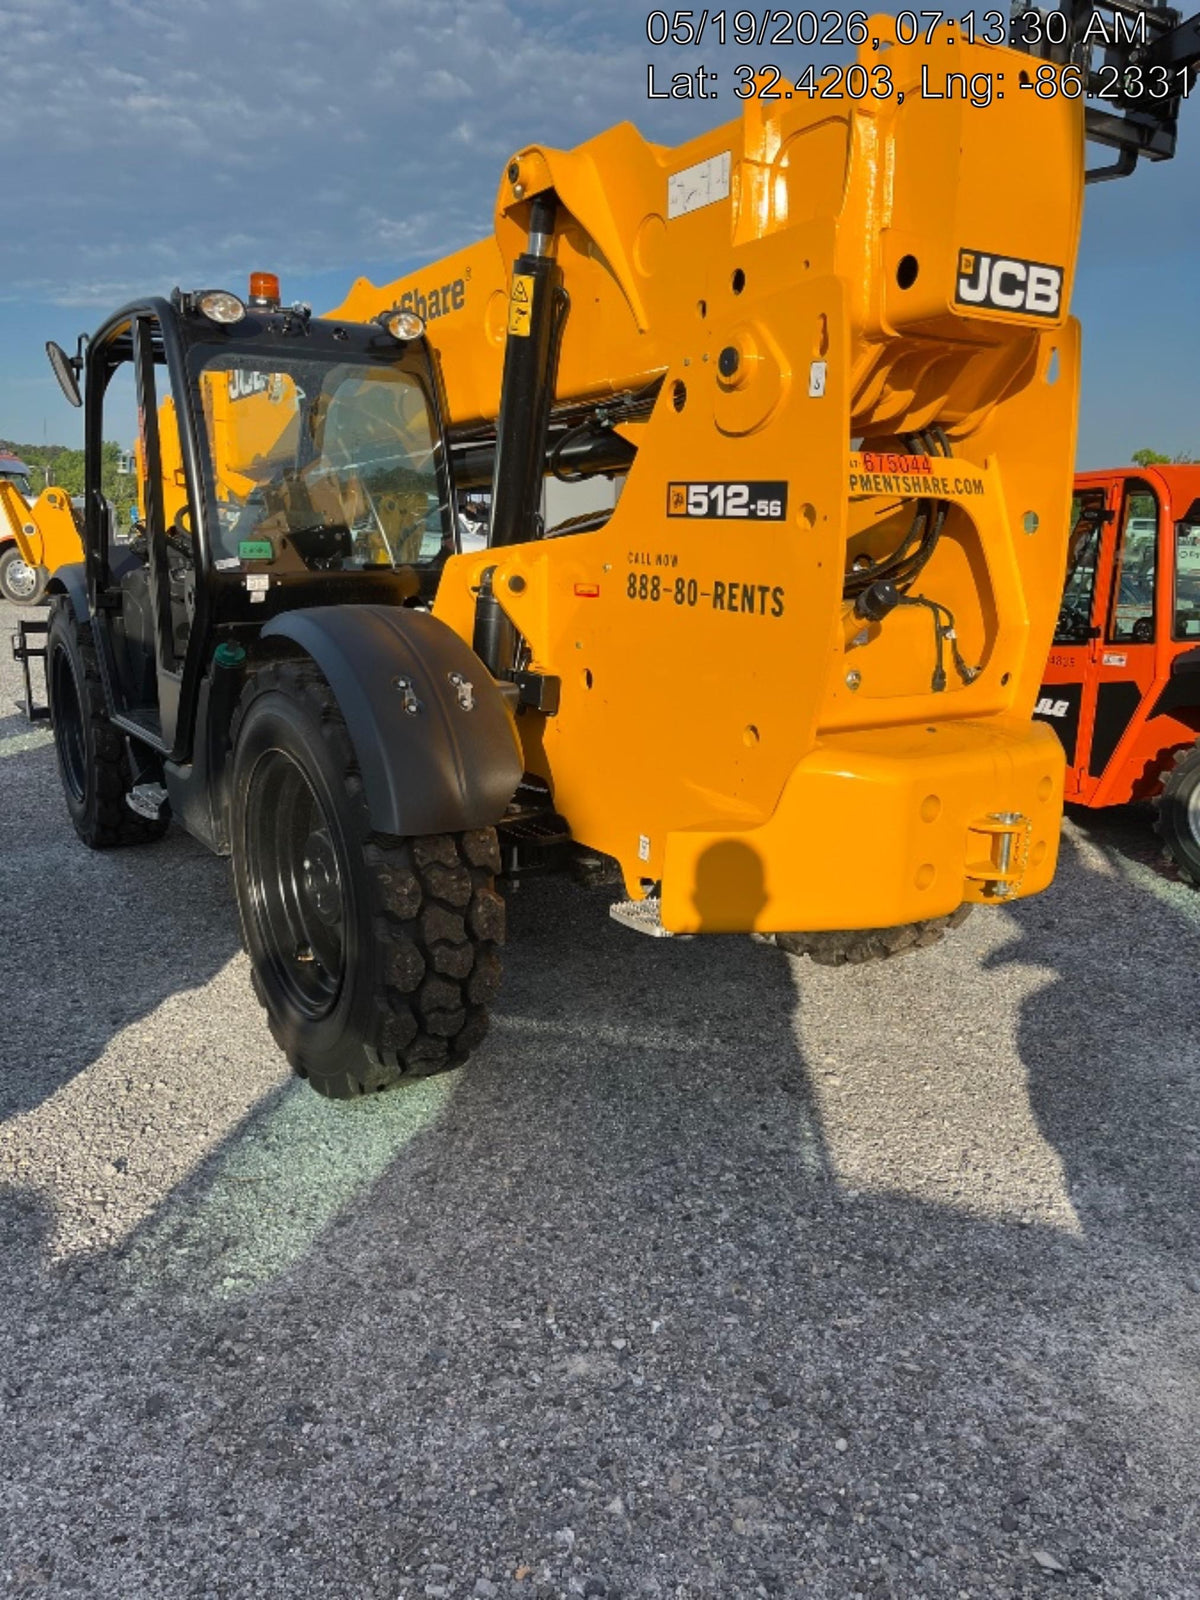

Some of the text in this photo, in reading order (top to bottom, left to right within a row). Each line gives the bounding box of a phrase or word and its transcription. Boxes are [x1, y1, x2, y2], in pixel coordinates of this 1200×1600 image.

[959, 257, 1060, 313] JCB
[687, 484, 782, 517] 512-56
[627, 551, 678, 568] CALL NOW
[626, 572, 785, 618] 888-80-RENTS
